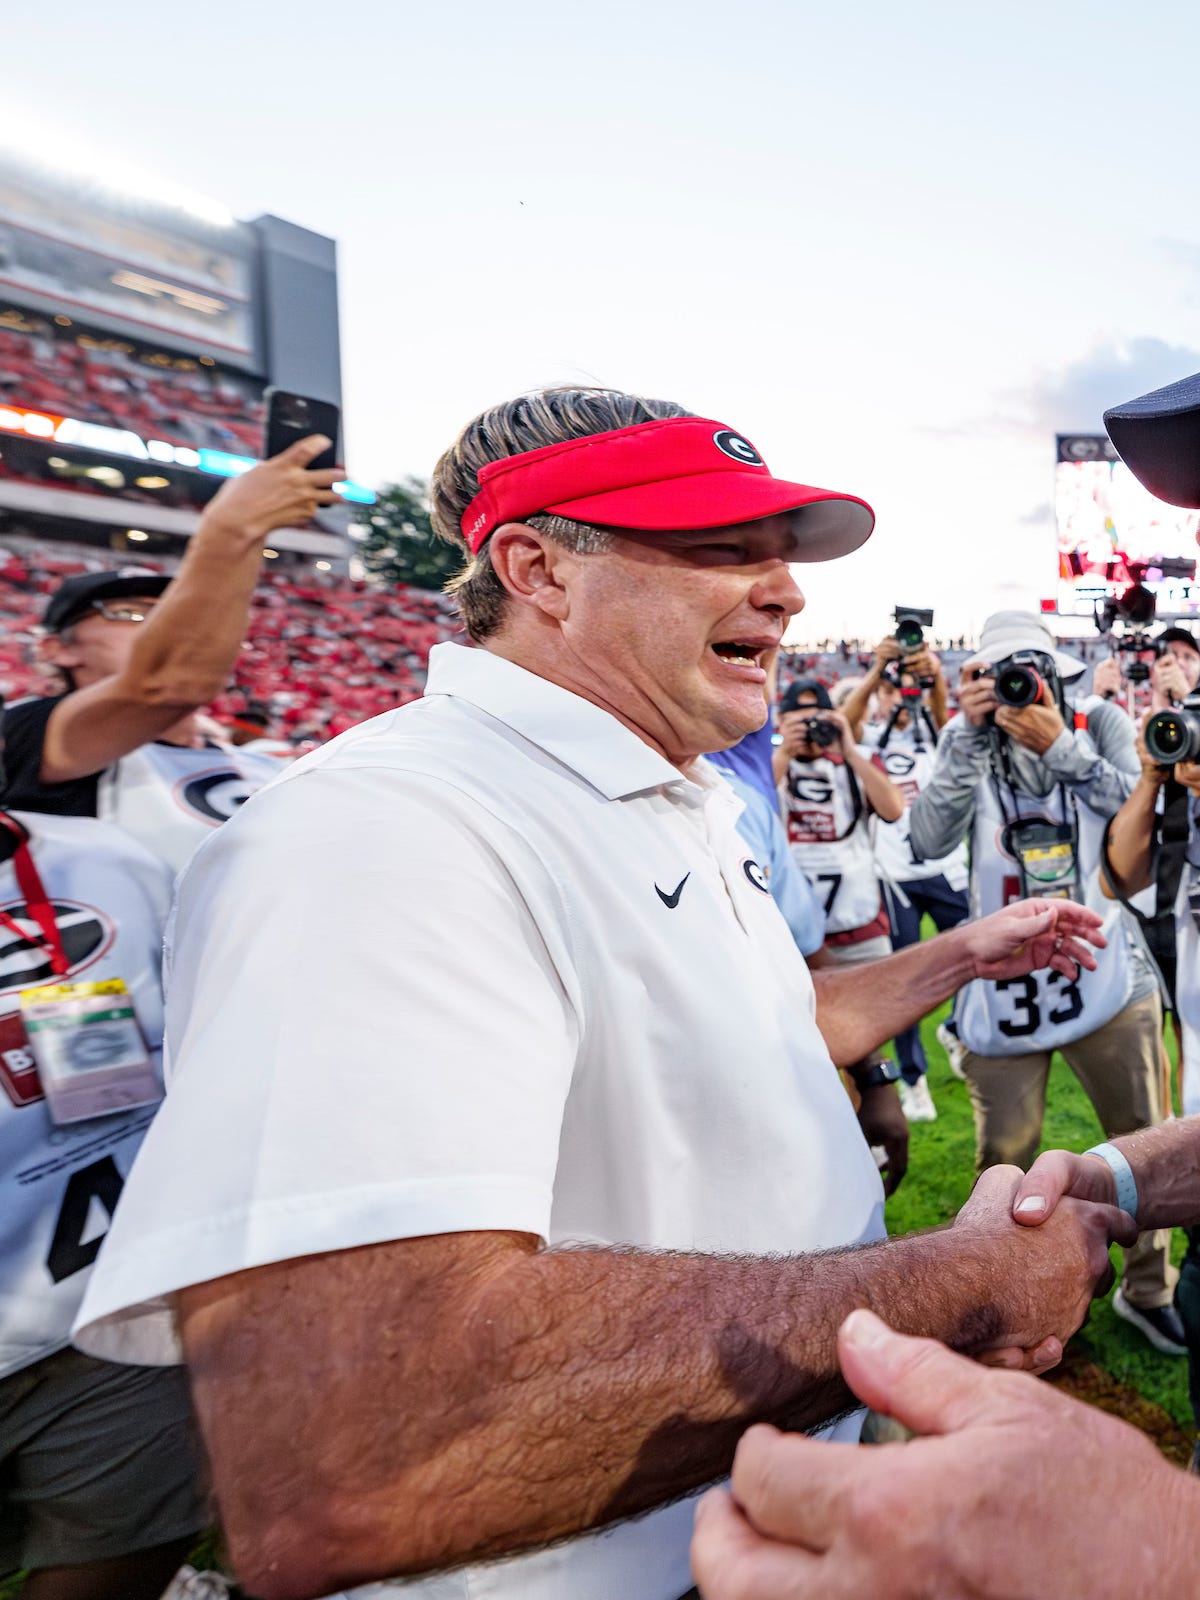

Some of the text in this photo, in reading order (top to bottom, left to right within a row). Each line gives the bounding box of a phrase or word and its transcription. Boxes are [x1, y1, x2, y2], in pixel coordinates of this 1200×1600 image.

[714, 431, 763, 466] G
[789, 776, 833, 804] G
[804, 874, 842, 918] 7
[995, 961, 1084, 1036] 33
